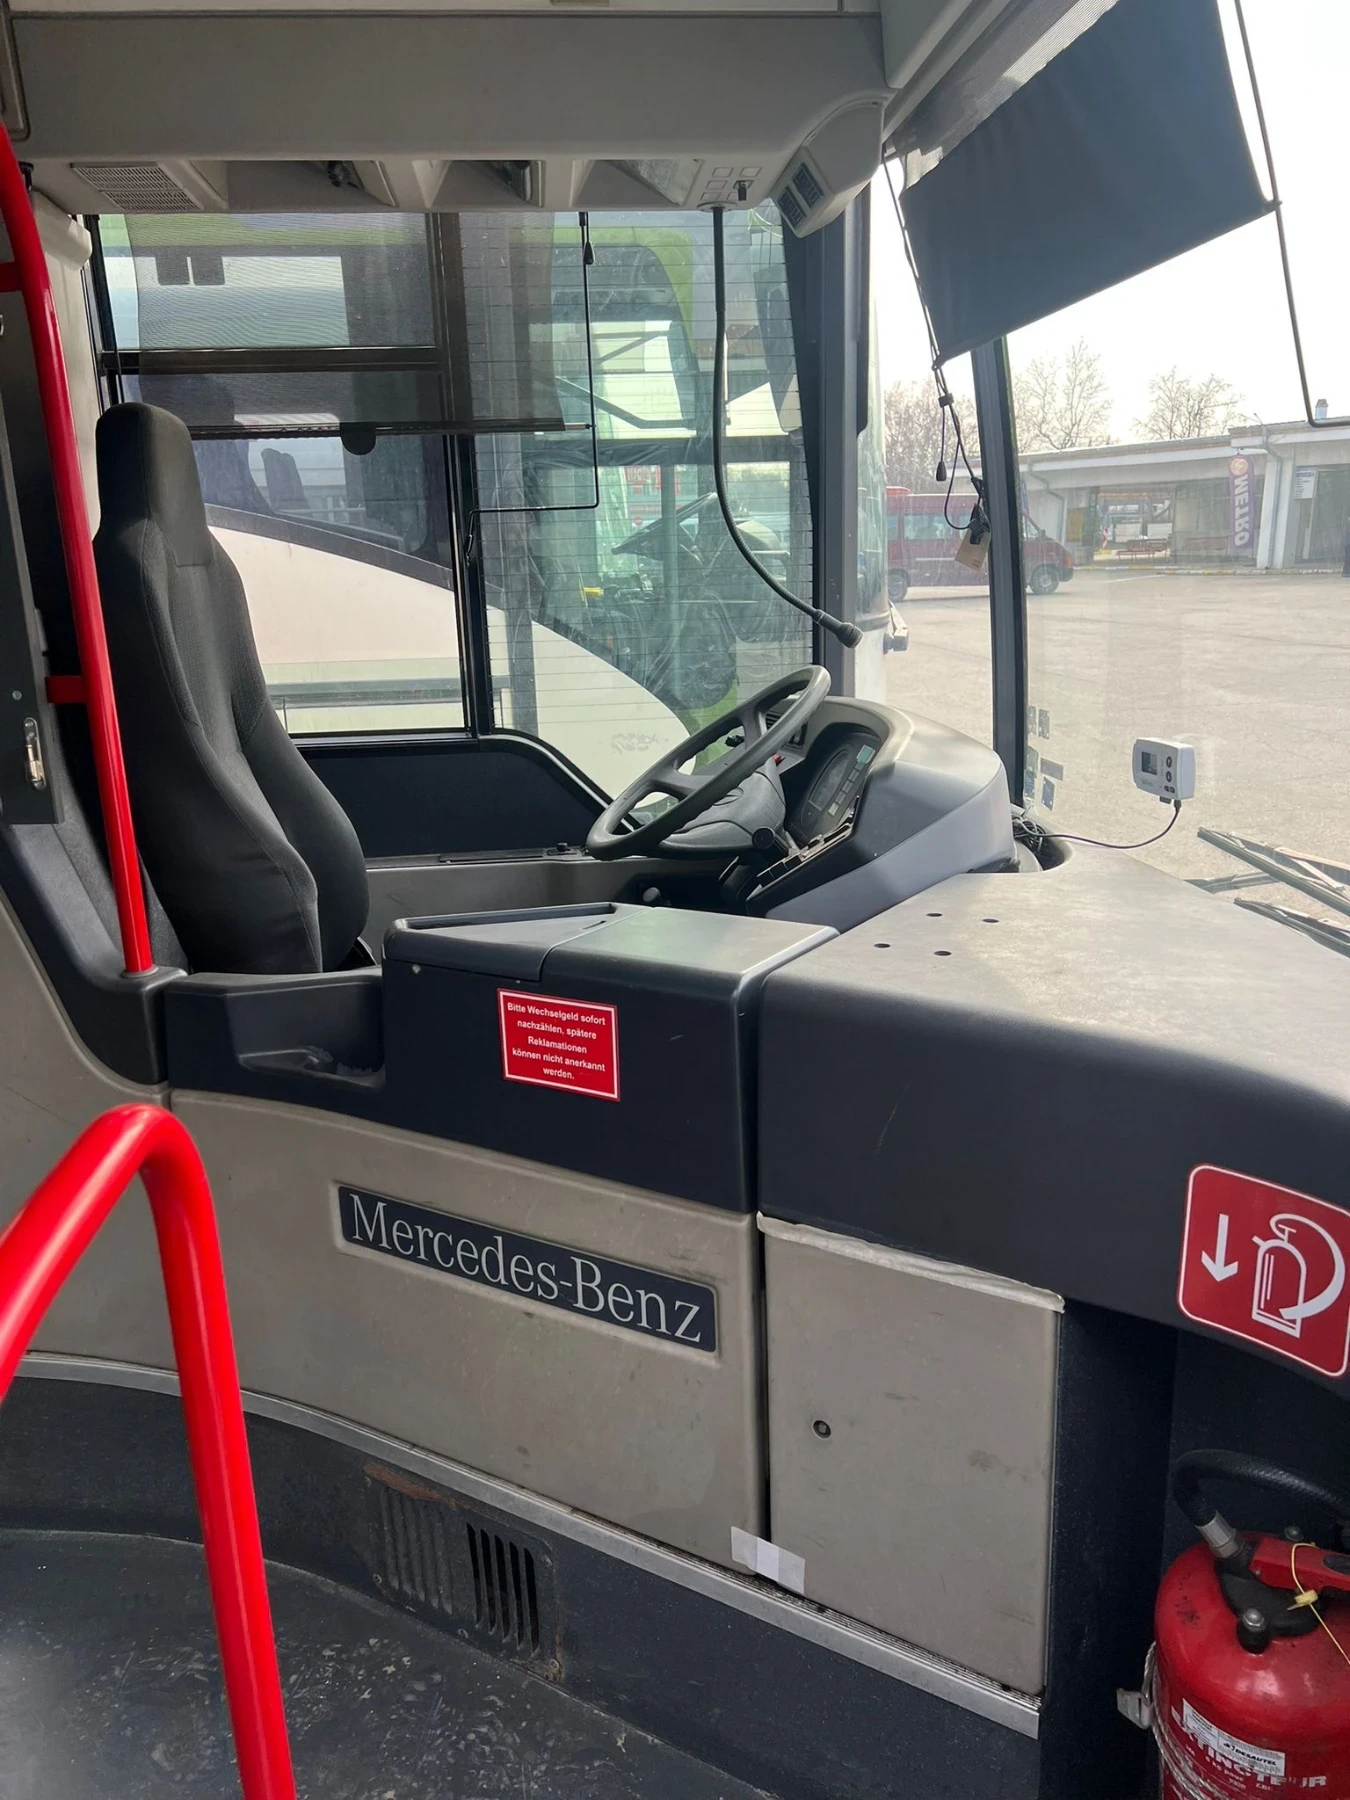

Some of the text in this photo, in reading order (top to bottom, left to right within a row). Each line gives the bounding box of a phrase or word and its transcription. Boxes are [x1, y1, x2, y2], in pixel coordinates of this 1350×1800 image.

[1234, 475, 1250, 547] METRO
[507, 1002, 606, 1026] Bitte Wechselgeld sofort
[517, 1020, 597, 1040] nachzählen, spätere
[527, 1036, 587, 1054] Reklamationen
[512, 1047, 606, 1072] können nicht anerkannt
[543, 1067, 575, 1080] werden.
[349, 1193, 702, 1343] Mercedes-Benz
[1235, 1748, 1277, 1766] DESAUTEL
